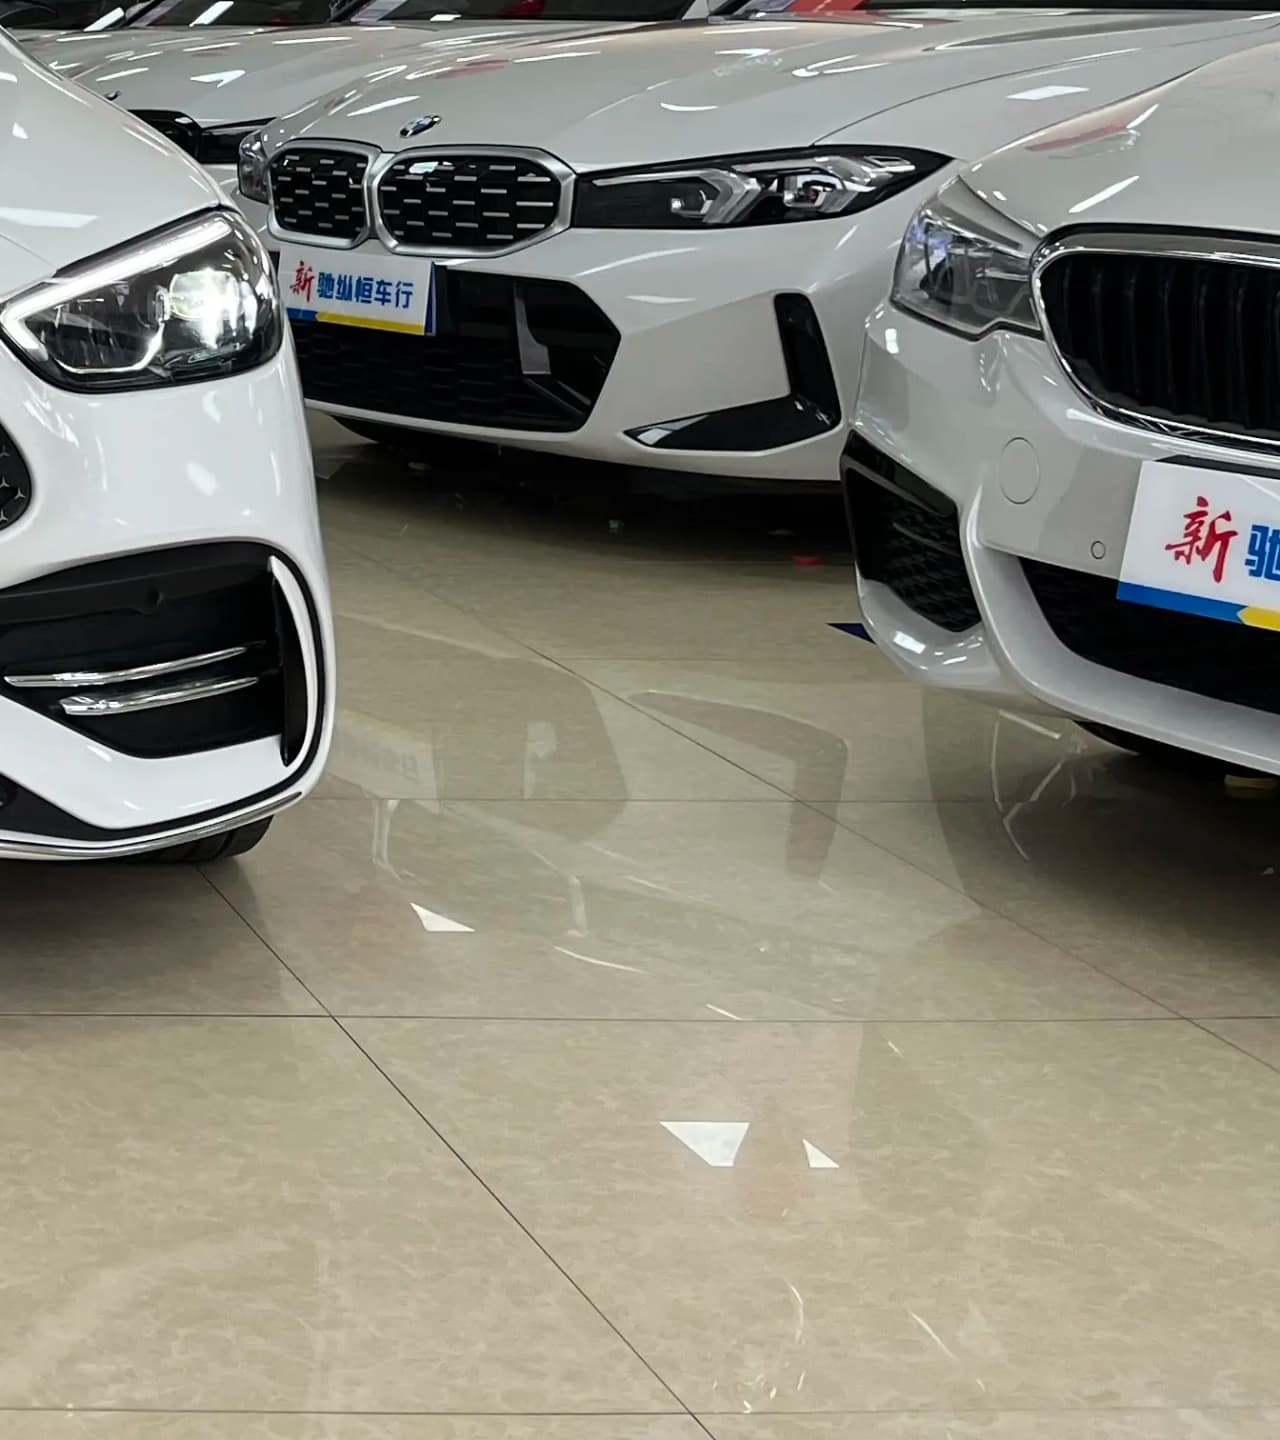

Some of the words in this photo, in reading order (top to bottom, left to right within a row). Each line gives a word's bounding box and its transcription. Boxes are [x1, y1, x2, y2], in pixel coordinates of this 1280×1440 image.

[290, 260, 414, 309] 新驰纵恒车行
